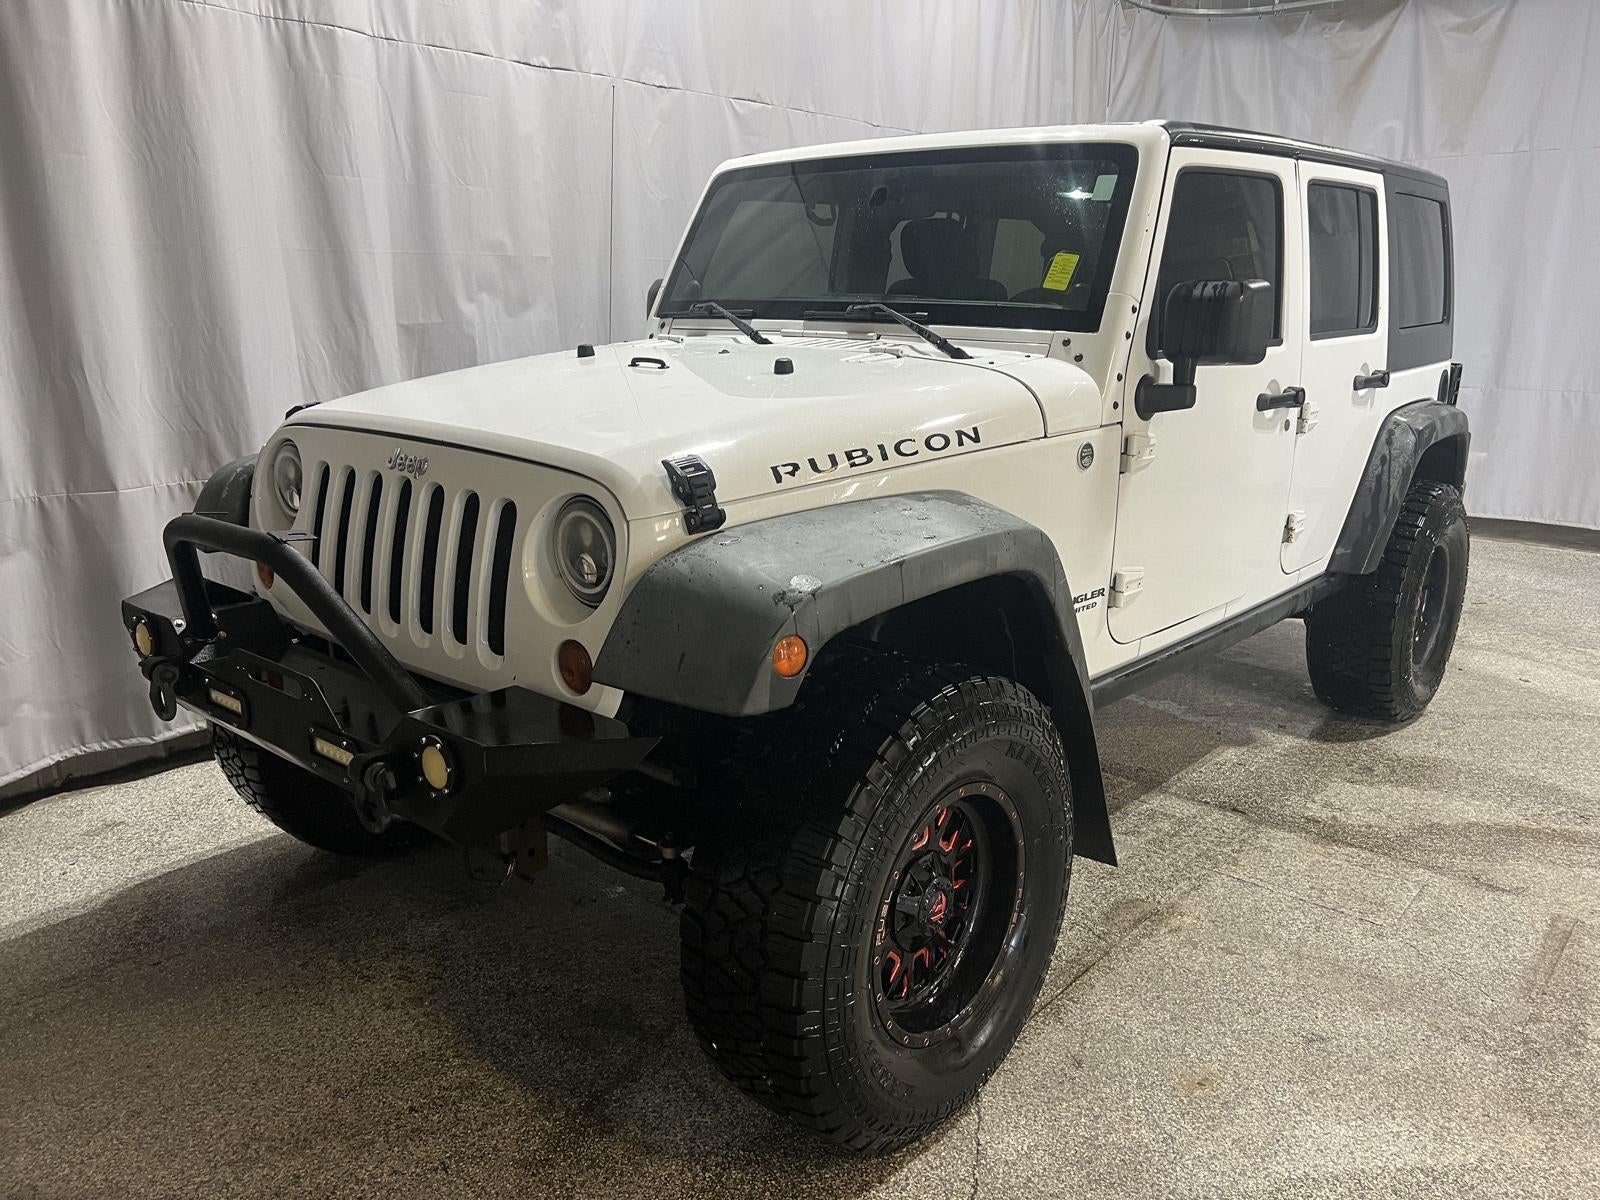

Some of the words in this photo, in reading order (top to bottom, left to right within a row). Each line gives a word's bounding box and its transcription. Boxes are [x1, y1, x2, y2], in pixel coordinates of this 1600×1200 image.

[387, 447, 428, 480] Jeep
[770, 426, 981, 484] RUBICON
[875, 890, 893, 947] FUEL
